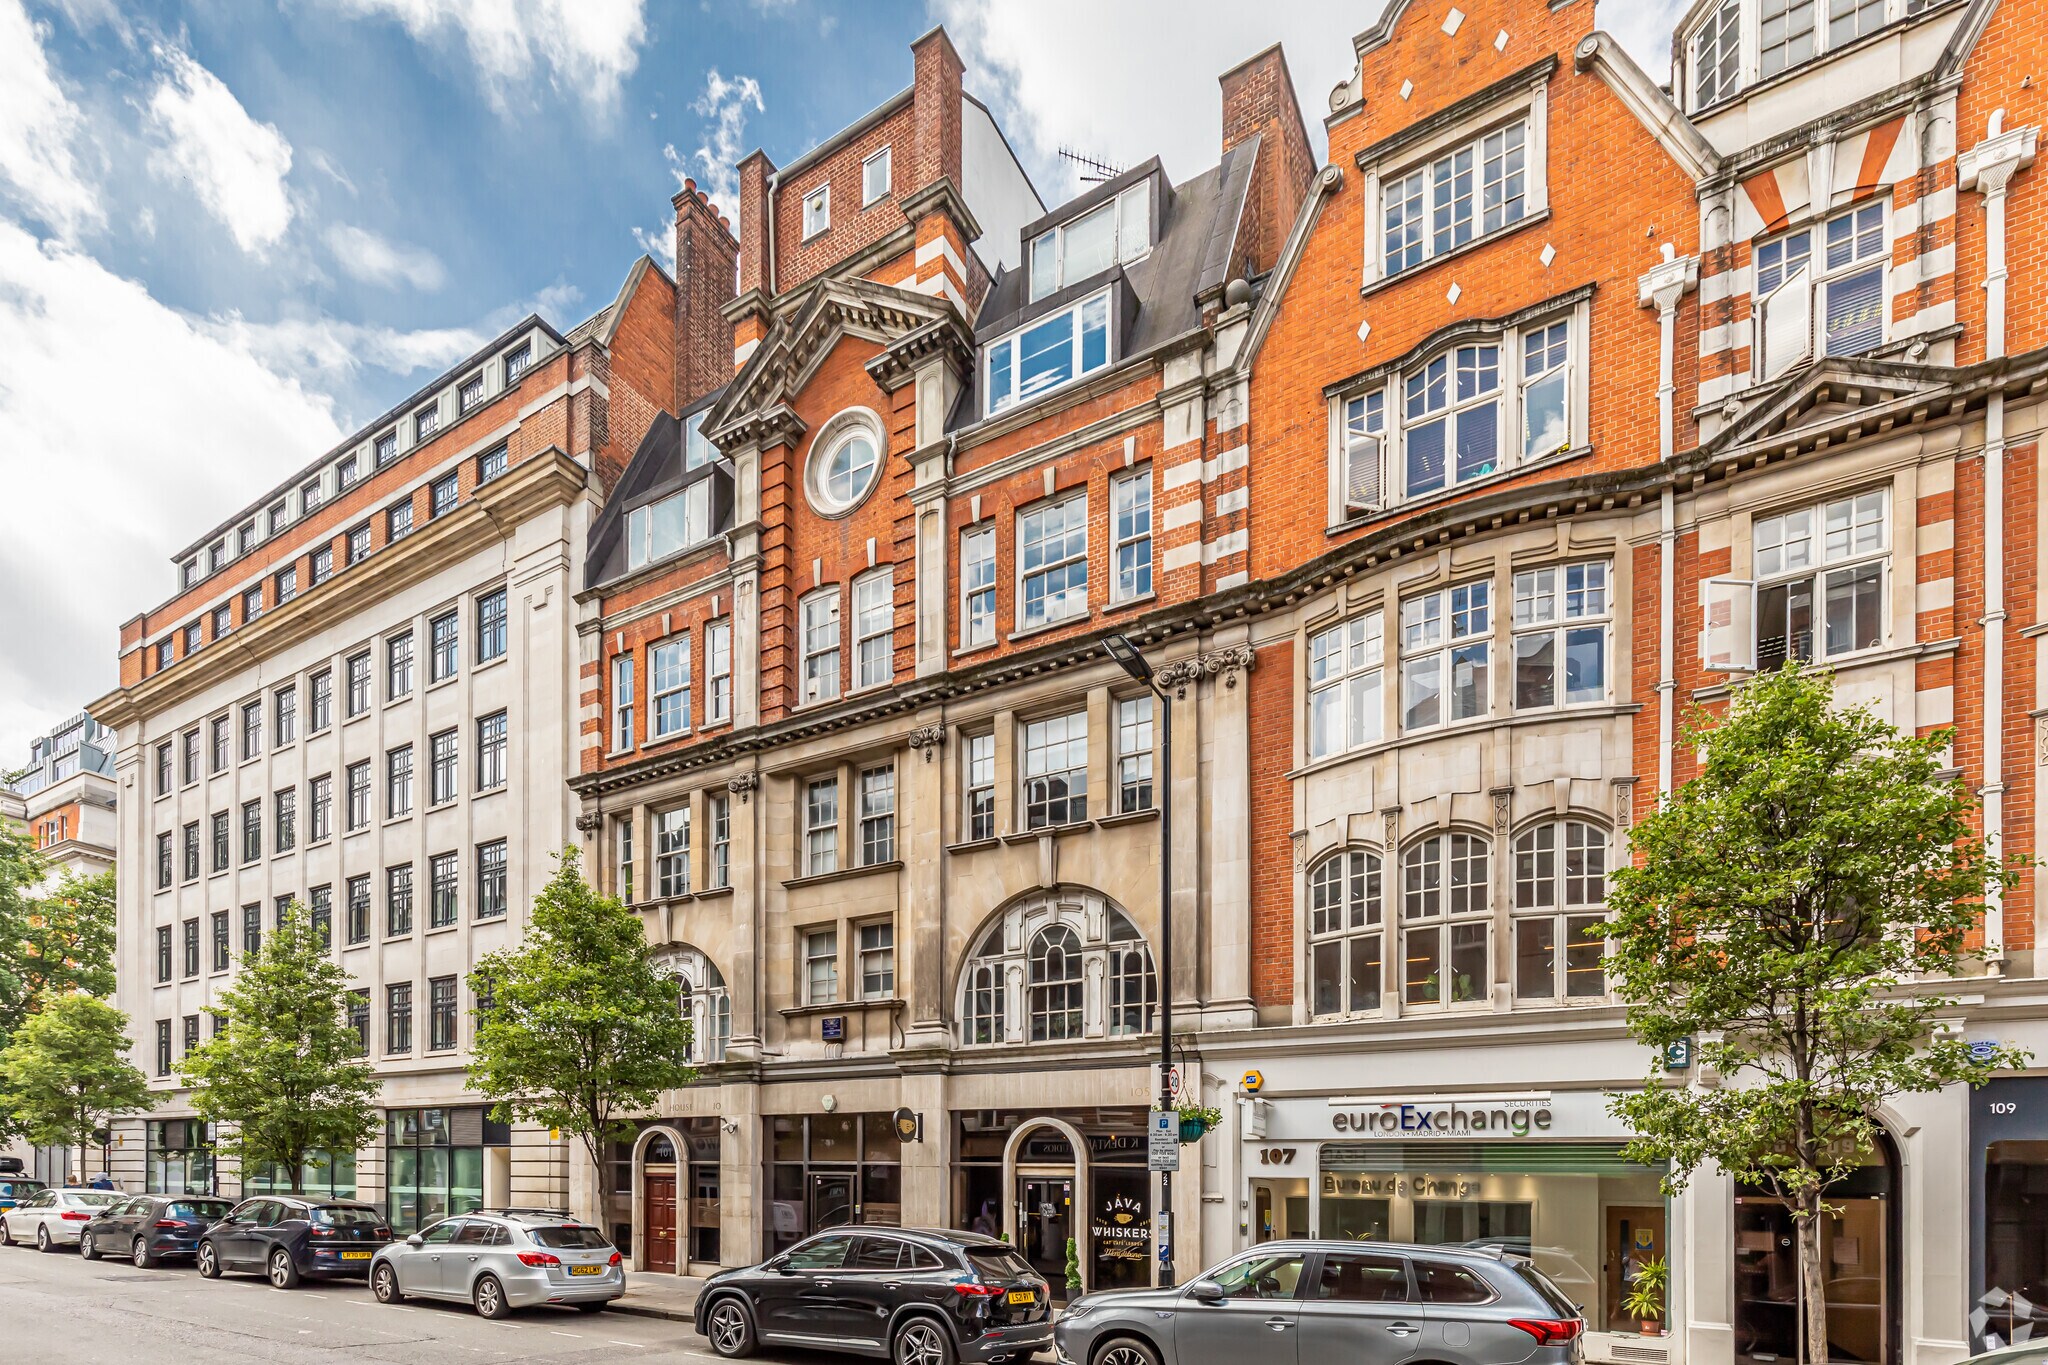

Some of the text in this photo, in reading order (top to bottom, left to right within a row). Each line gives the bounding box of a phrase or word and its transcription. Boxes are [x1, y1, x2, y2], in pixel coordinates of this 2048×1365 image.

[1171, 1077, 1178, 1087] 20
[1130, 1087, 1150, 1097] 105
[669, 1104, 693, 1112] HOUSE
[1504, 1100, 1552, 1108] SECURITIES
[1989, 1102, 2017, 1114] 109
[1332, 1102, 1552, 1137] euroExchange
[660, 1147, 672, 1157] 101
[1260, 1148, 1296, 1165] 107
[1324, 1177, 1480, 1197] Bureau de Change
[1105, 1197, 1142, 1213] JAVA
